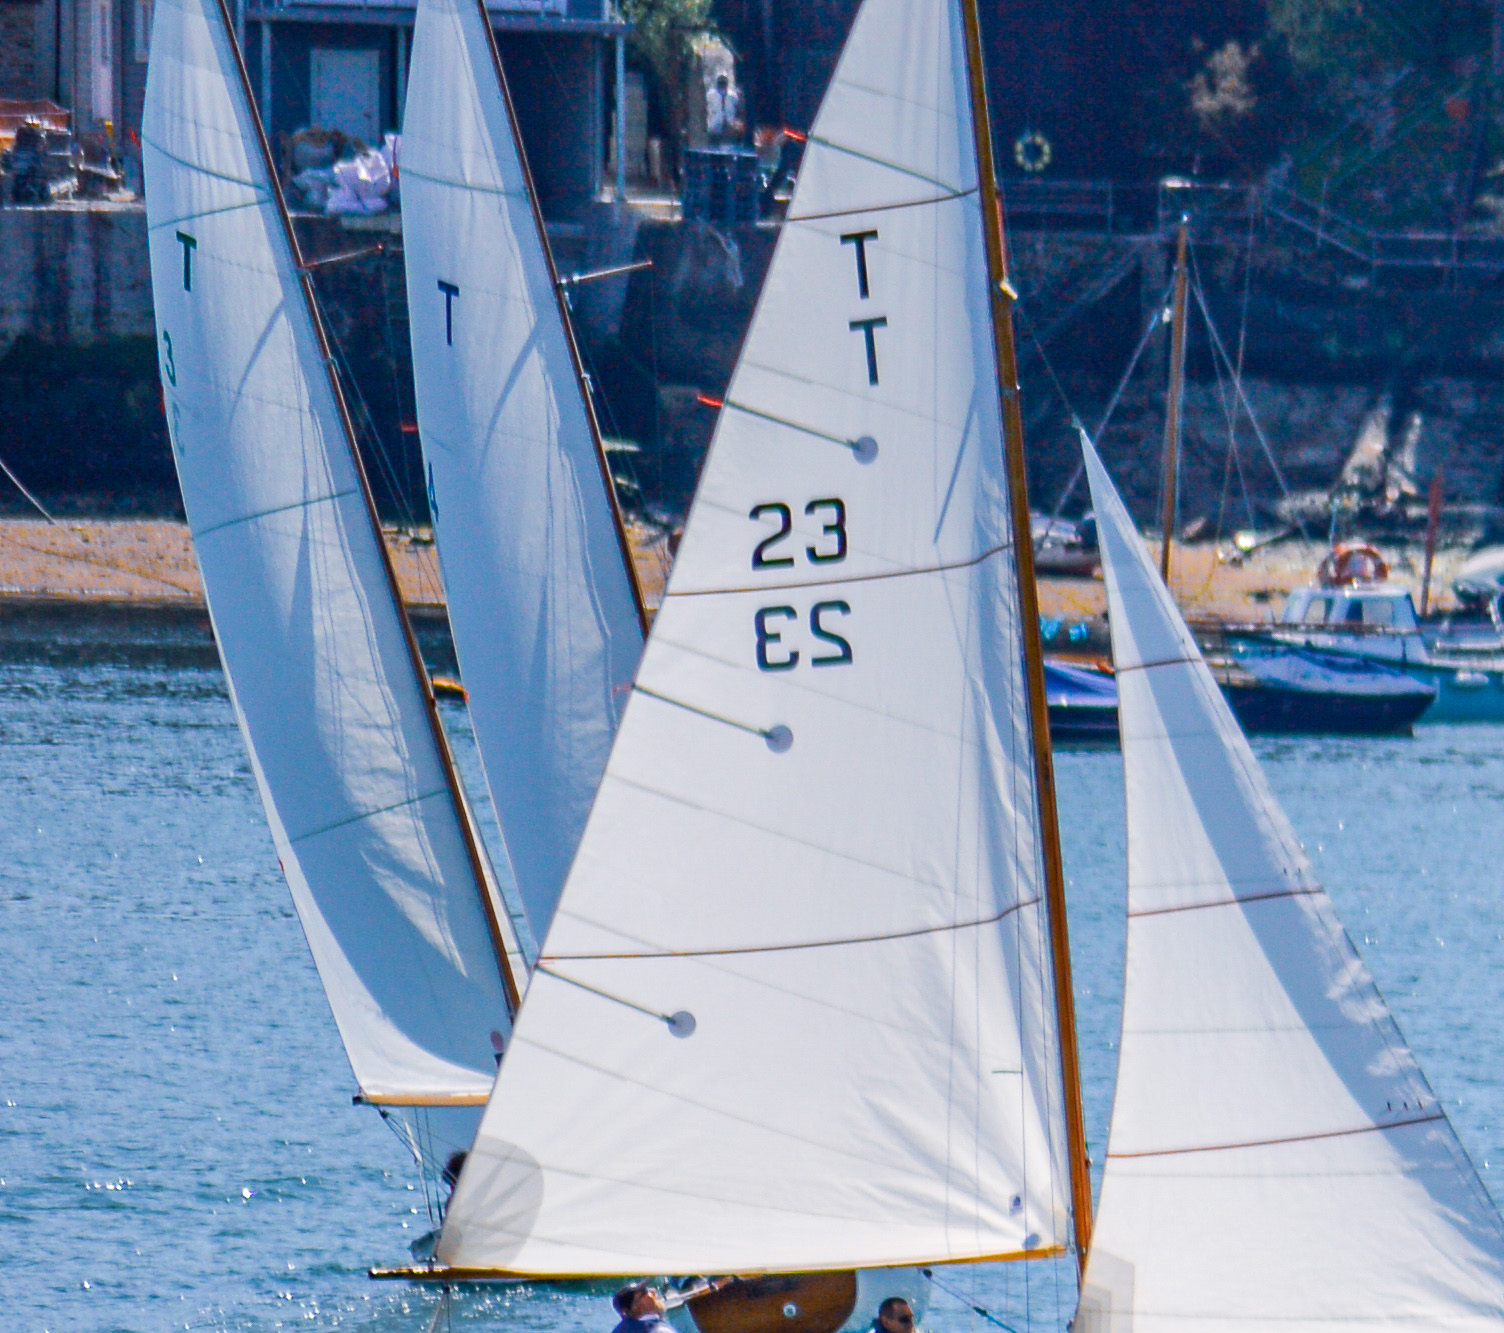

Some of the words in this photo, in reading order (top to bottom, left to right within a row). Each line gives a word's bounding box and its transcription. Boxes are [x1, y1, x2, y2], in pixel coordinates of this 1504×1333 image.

[176, 230, 197, 291] T
[840, 230, 878, 299] T
[437, 280, 459, 346] T
[849, 316, 887, 386] T
[748, 498, 847, 571] 23
